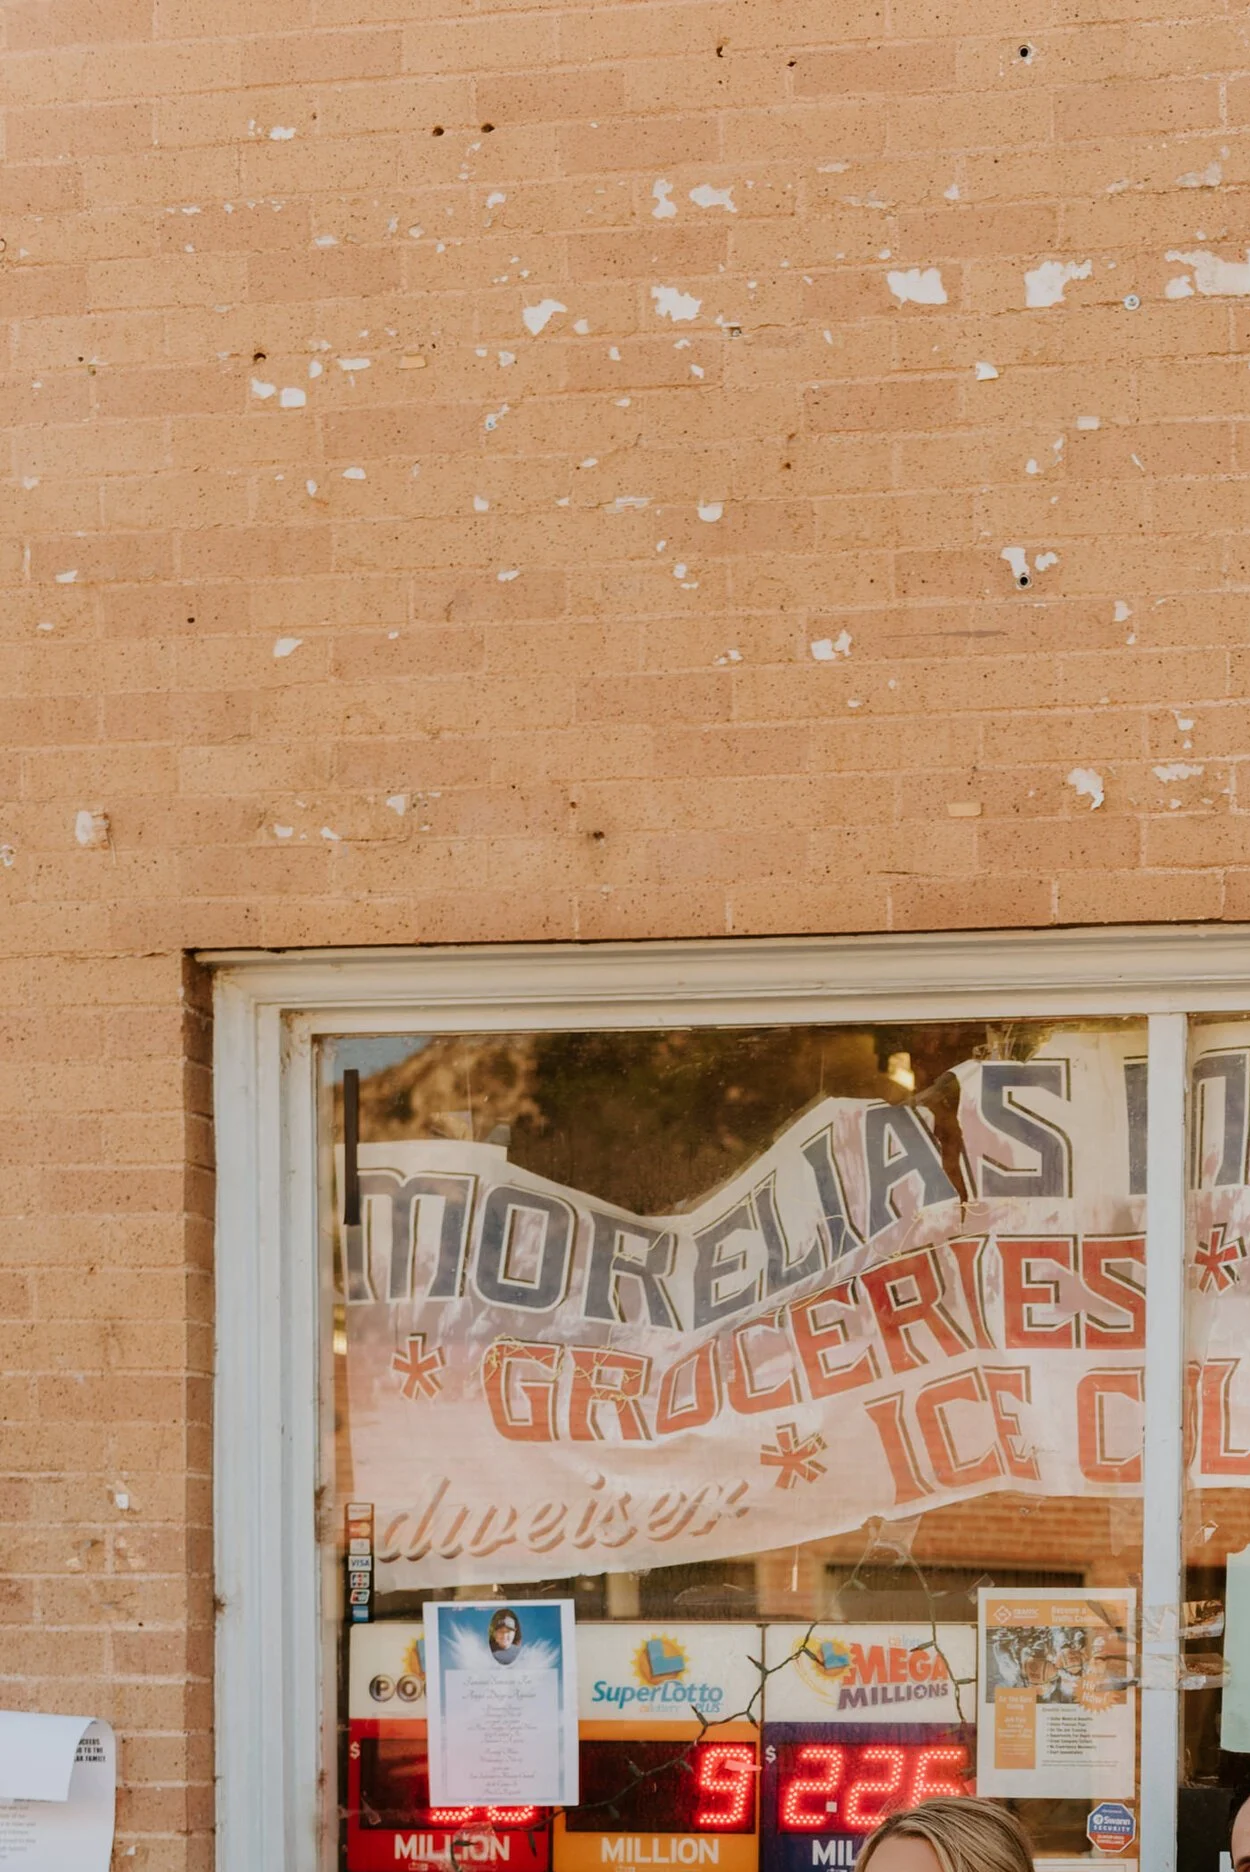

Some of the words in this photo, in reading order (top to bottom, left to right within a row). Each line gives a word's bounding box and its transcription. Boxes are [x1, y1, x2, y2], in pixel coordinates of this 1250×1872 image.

[482, 1231, 1148, 1444] GROCERIES
[865, 1365, 1041, 1506] ICE
[351, 1560, 370, 1569] VISA
[841, 1642, 950, 1687] MEGA
[591, 1680, 724, 1709] SuperLotto
[837, 1683, 949, 1711] MILLIONS
[349, 1741, 361, 1759] $
[764, 1744, 777, 1764] $
[699, 1746, 756, 1825] 9
[1093, 1825, 1131, 1833] SECURITY
[394, 1834, 511, 1862] MILLION
[601, 1837, 720, 1865] MILLION
